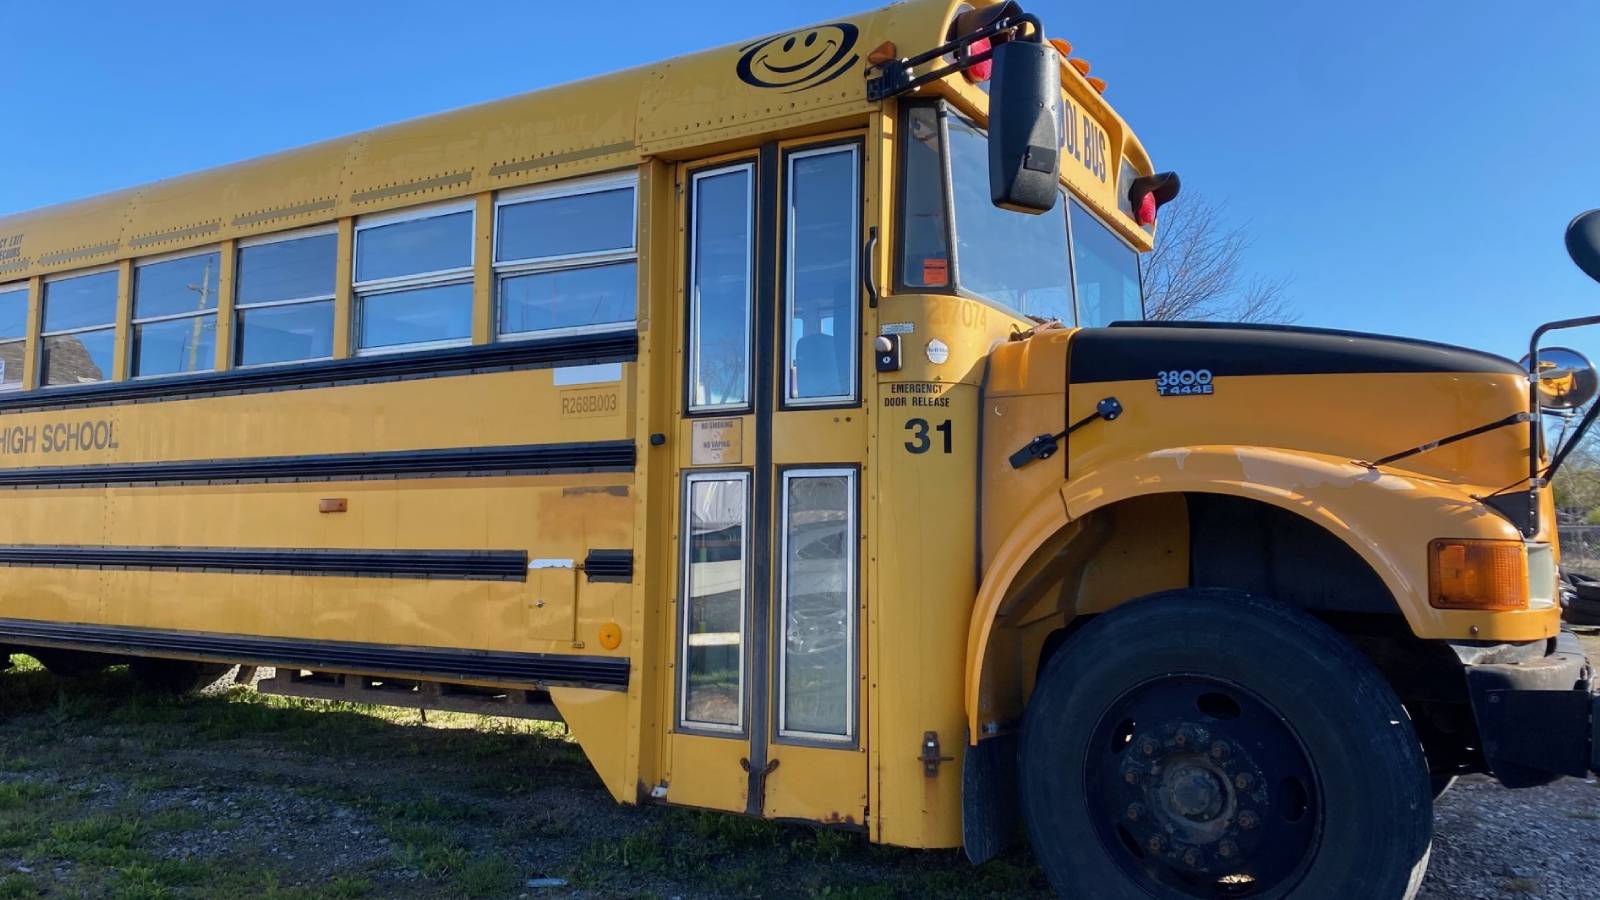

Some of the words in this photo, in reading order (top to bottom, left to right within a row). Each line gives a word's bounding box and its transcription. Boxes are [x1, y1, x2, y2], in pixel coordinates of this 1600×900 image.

[1083, 114, 1106, 184] BUS
[1157, 369, 1212, 386] 3800
[891, 383, 944, 394] EMERGENCY
[1158, 386, 1167, 395] T
[1170, 384, 1213, 394] 444E
[562, 393, 617, 415] R268B003
[884, 396, 907, 407] DOOR
[912, 396, 950, 408] RELEASE
[41, 420, 119, 453] SCHOOL
[904, 417, 952, 455] 31
